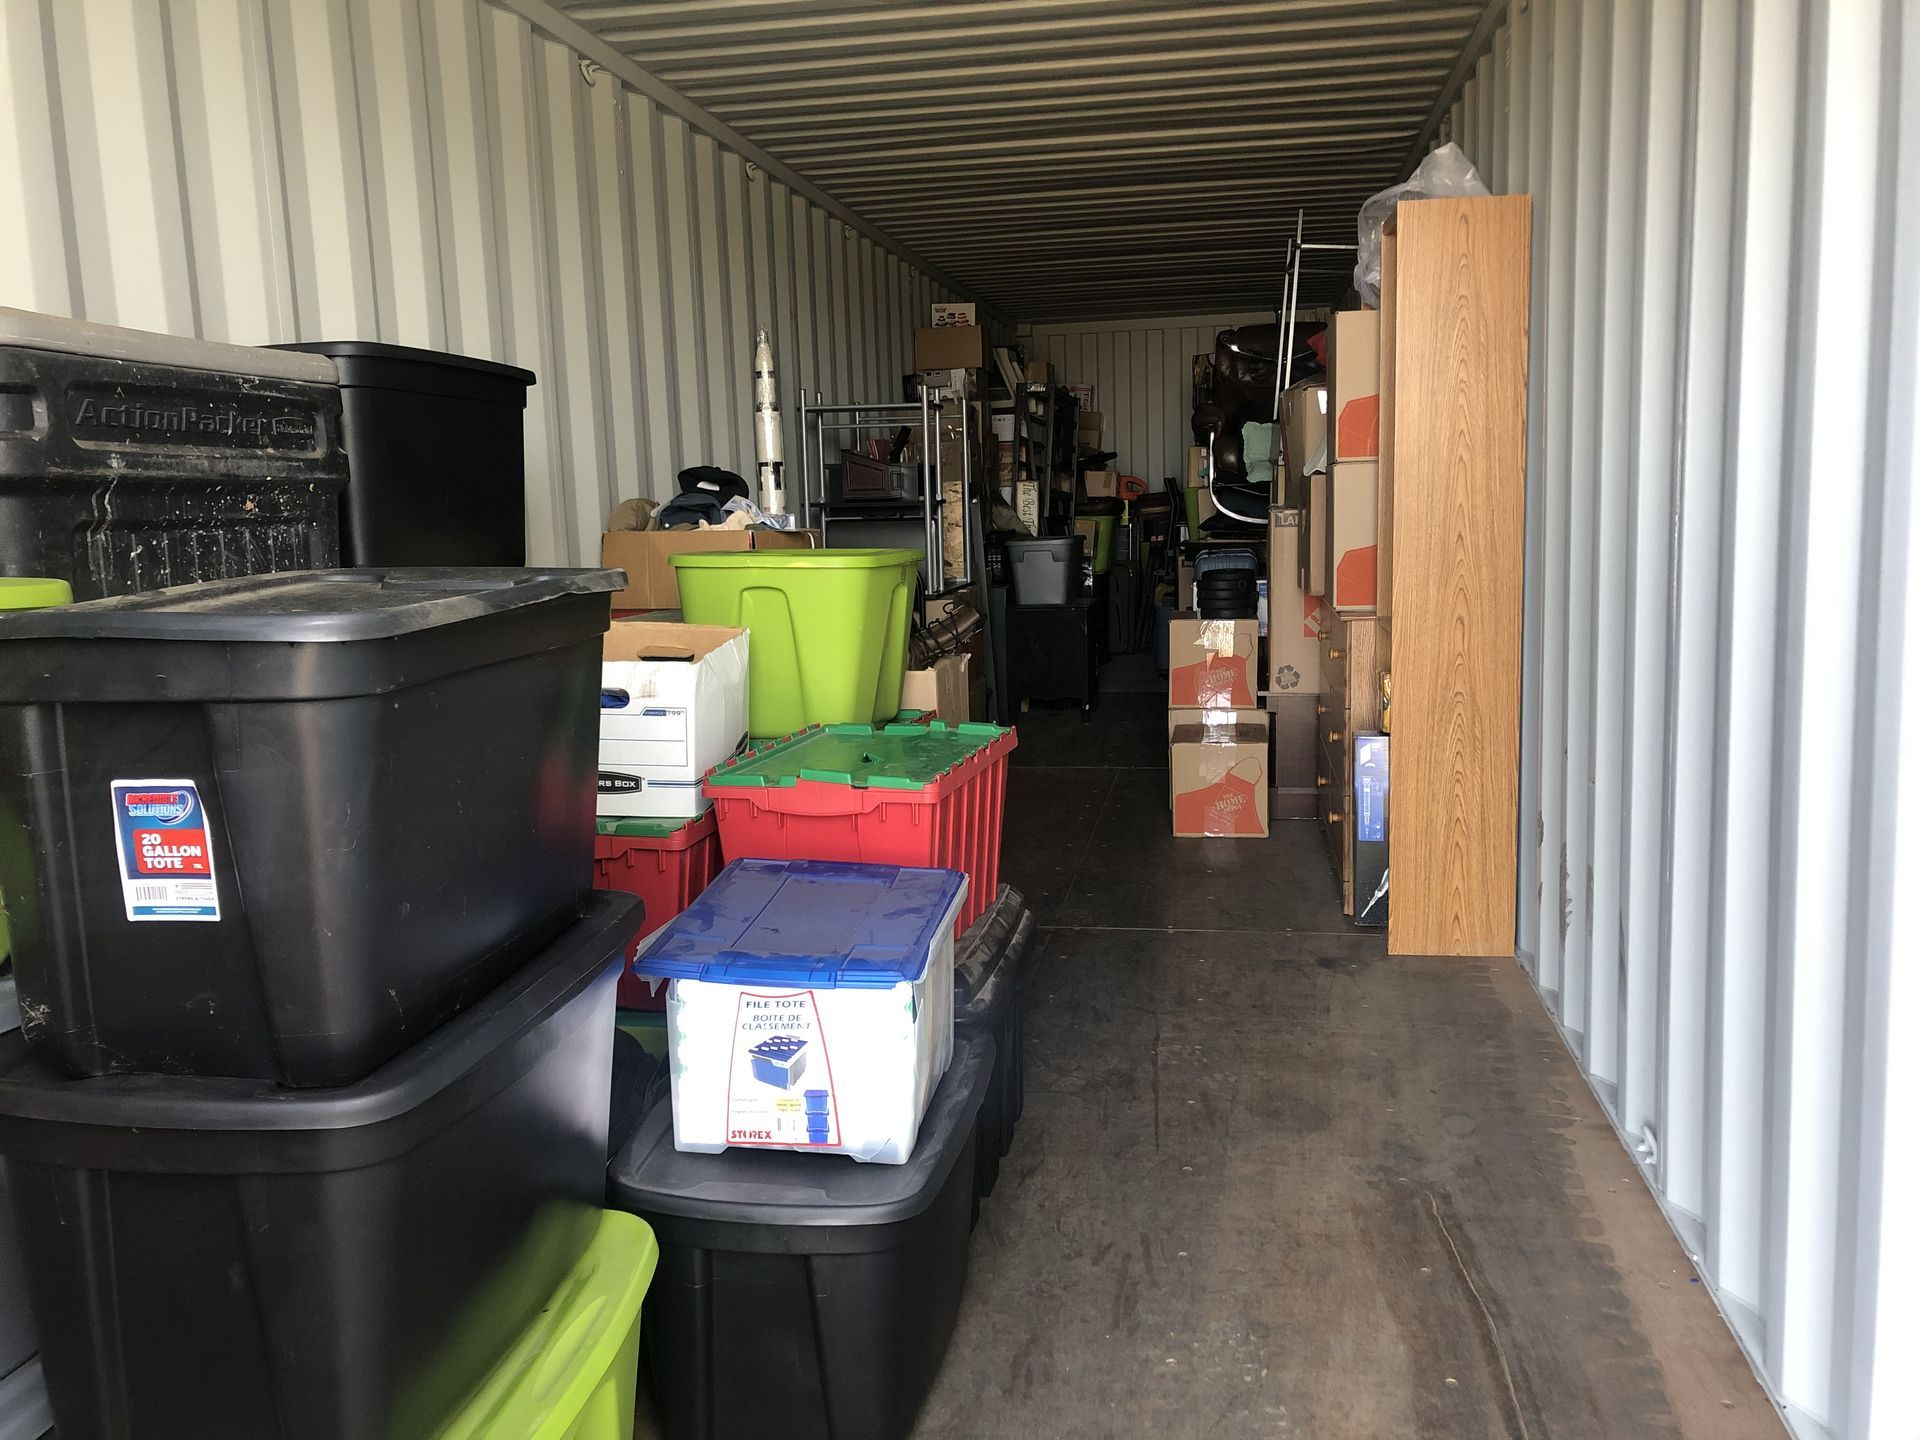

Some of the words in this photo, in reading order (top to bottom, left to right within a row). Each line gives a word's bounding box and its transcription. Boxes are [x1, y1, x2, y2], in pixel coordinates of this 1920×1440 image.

[1022, 482, 1036, 496] The
[1022, 498, 1035, 517] Best
[1022, 518, 1037, 531] Th
[1215, 794, 1247, 810] HOME
[128, 804, 184, 816] SOLUTIONS
[140, 833, 161, 845] 20
[142, 845, 202, 857] GALLON
[144, 857, 184, 869] TOTE
[746, 1000, 771, 1009] FILE
[774, 1000, 806, 1009] TOTE
[752, 1014, 785, 1022] BOITE
[788, 1014, 802, 1022] DE
